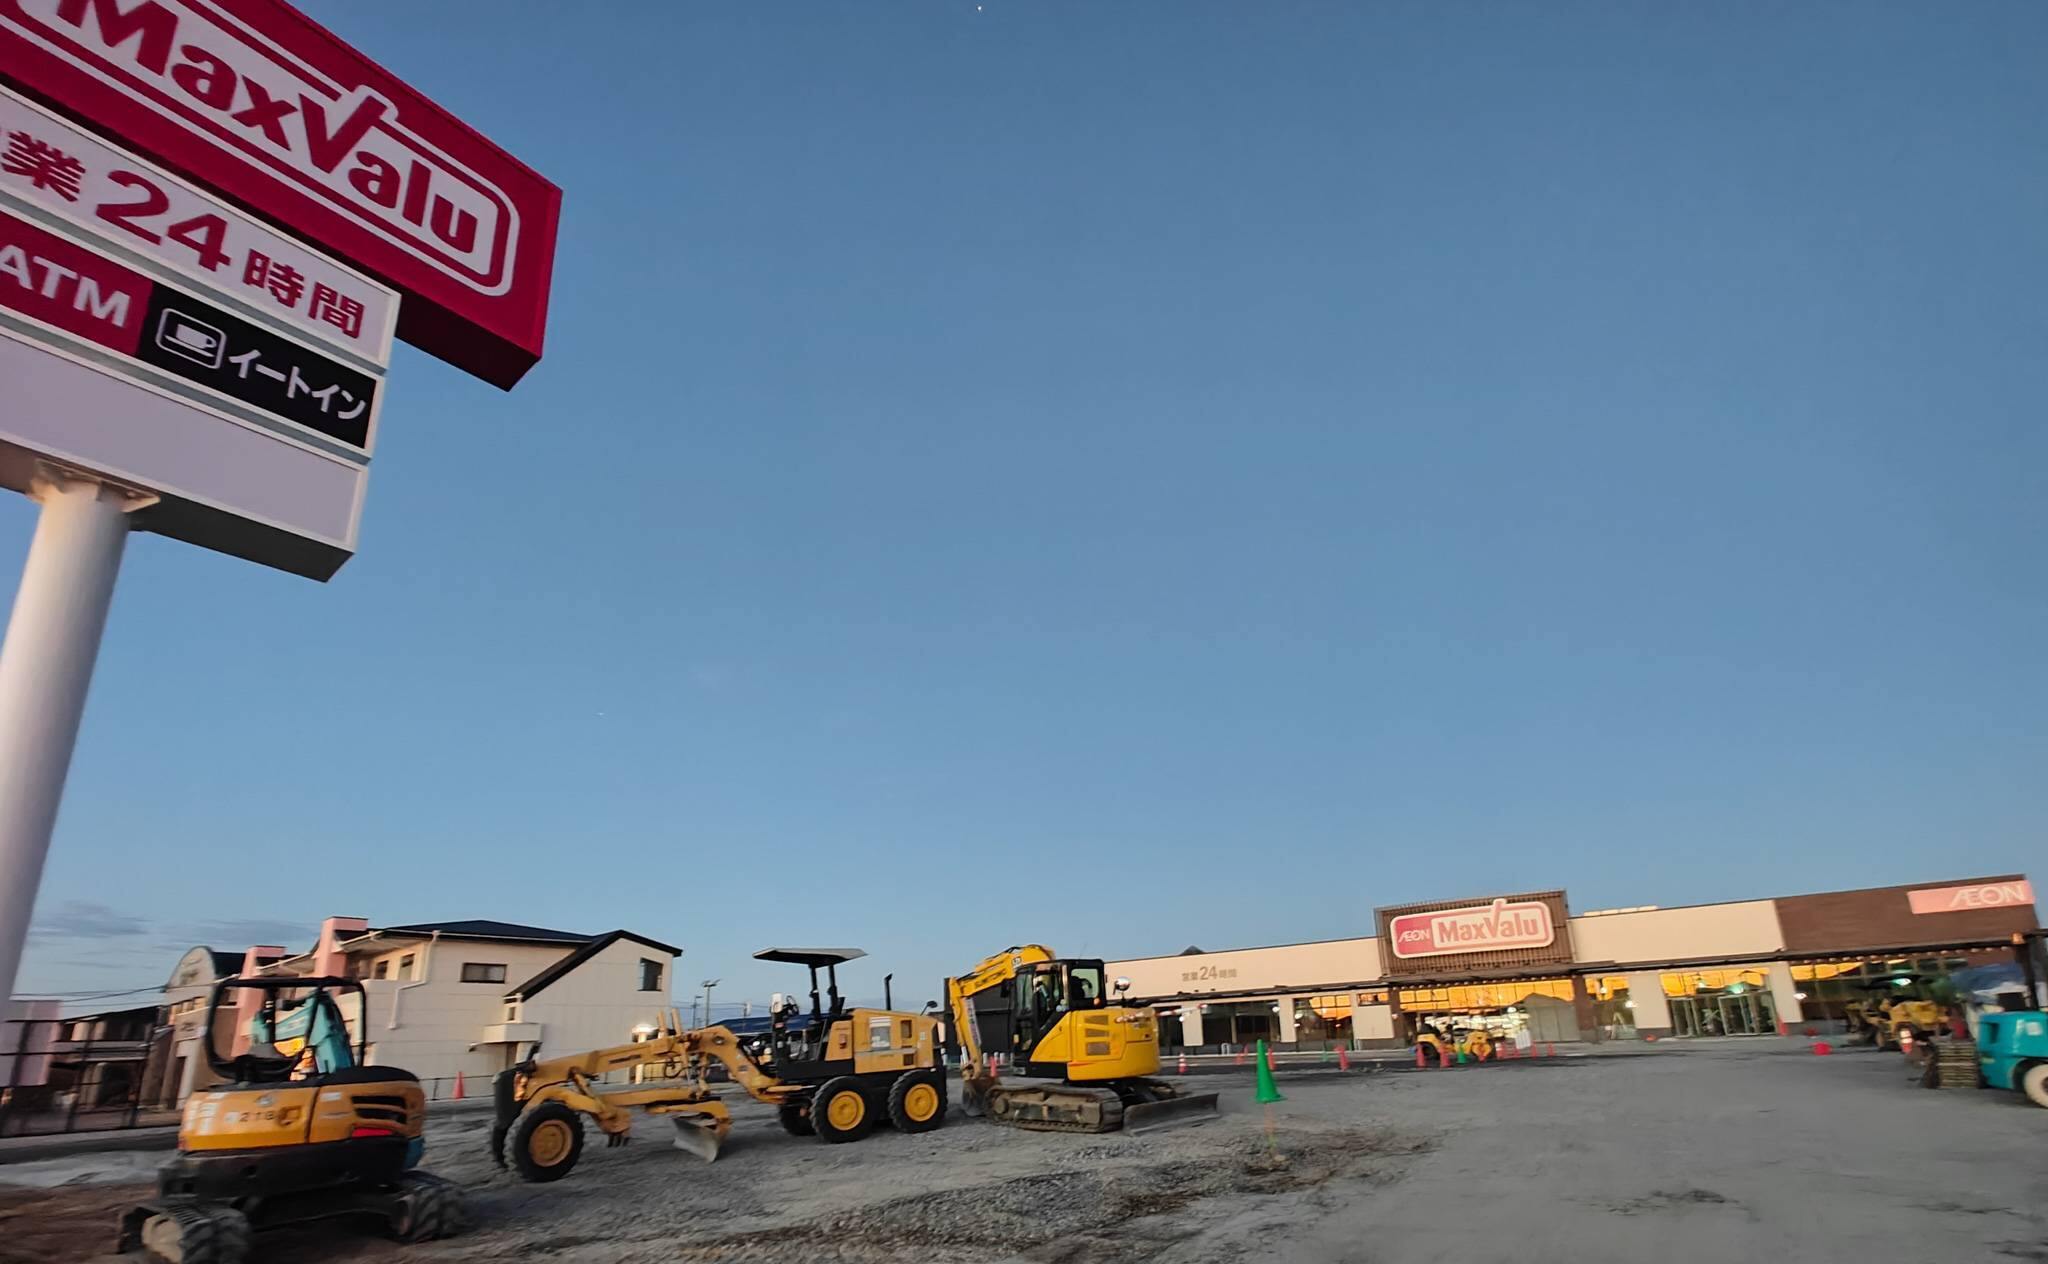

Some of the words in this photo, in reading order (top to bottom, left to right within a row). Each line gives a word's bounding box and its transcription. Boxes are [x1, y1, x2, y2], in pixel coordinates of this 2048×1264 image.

[56, 0, 479, 256] MaxValu
[0, 244, 131, 328] ATM
[229, 350, 366, 421] イートイン
[1437, 901, 1540, 944] MaxValu
